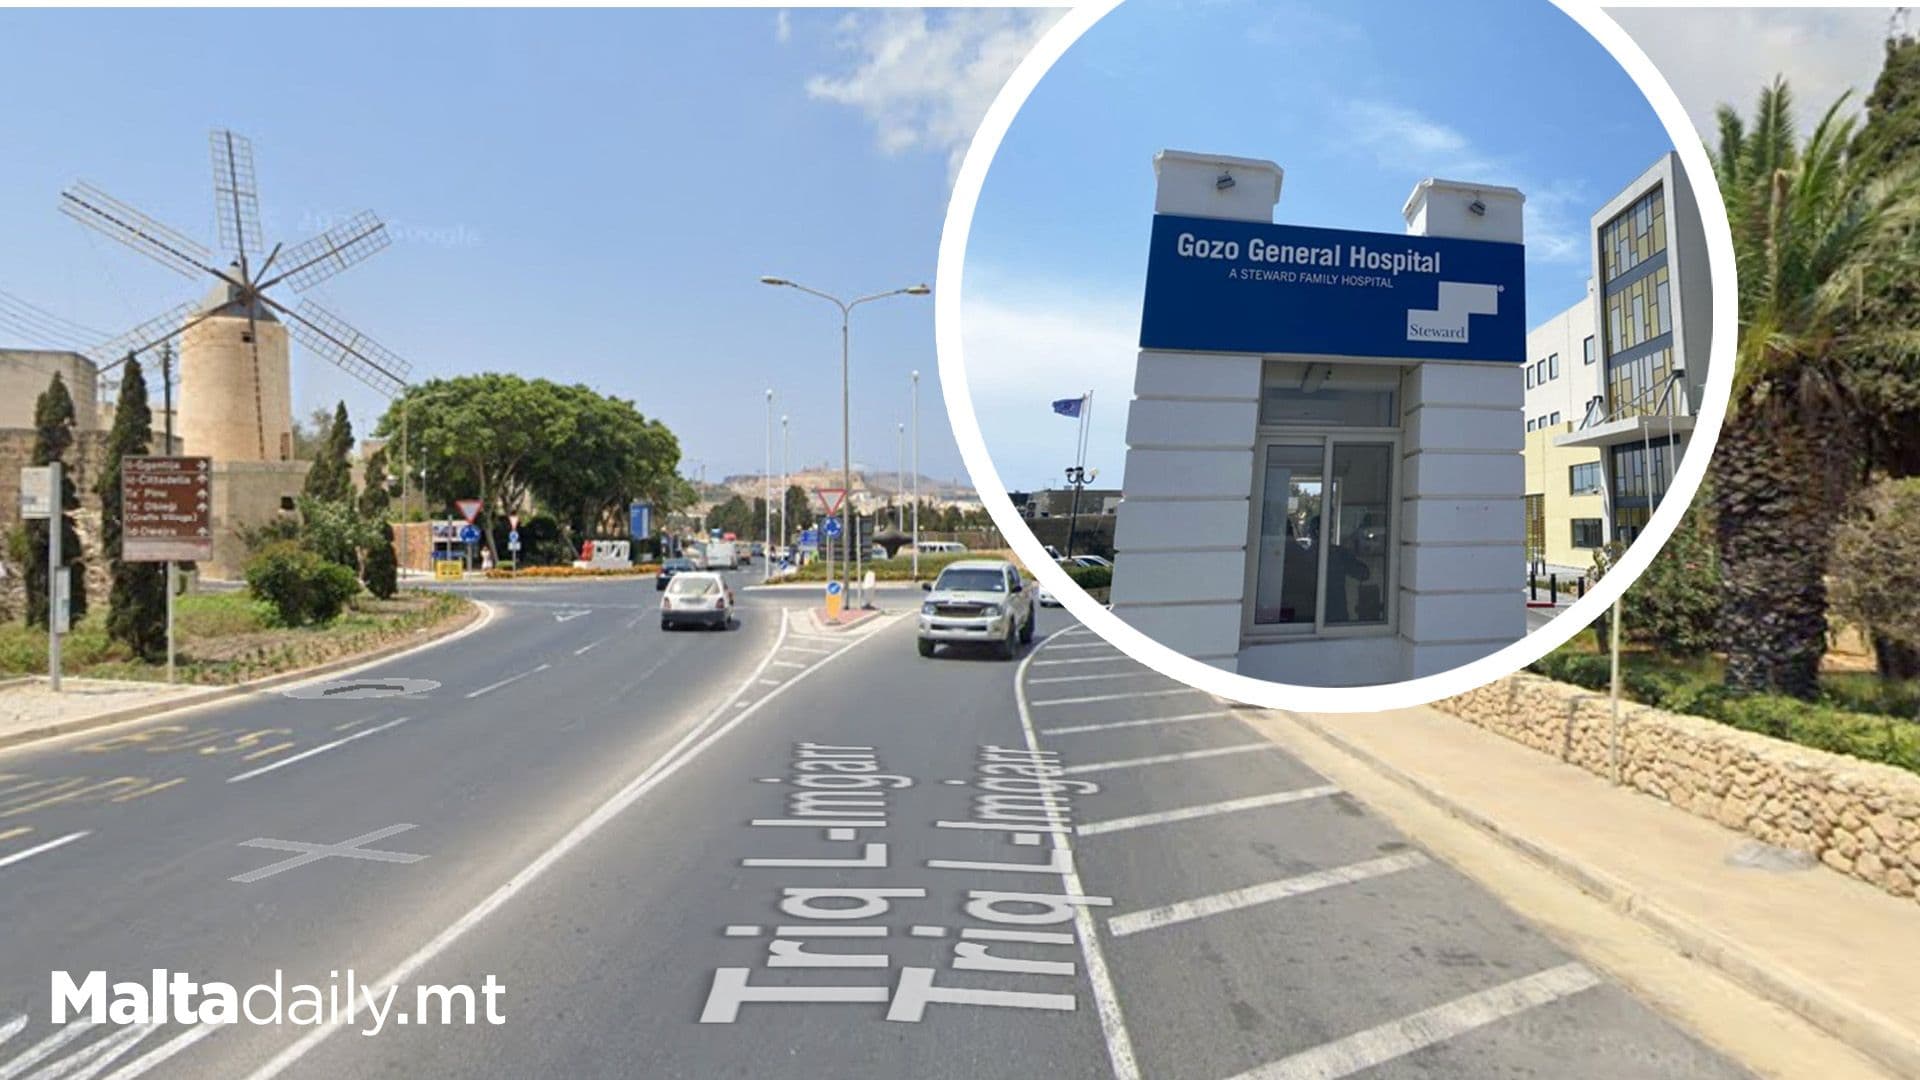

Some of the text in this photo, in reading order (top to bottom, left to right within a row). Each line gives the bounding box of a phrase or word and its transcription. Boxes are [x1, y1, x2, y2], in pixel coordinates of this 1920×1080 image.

[1177, 233, 1441, 275] Gozo General Hospital
[1229, 268, 1394, 289] A STEWARD FAMILY HOSPITAL
[1409, 322, 1466, 340] Steward
